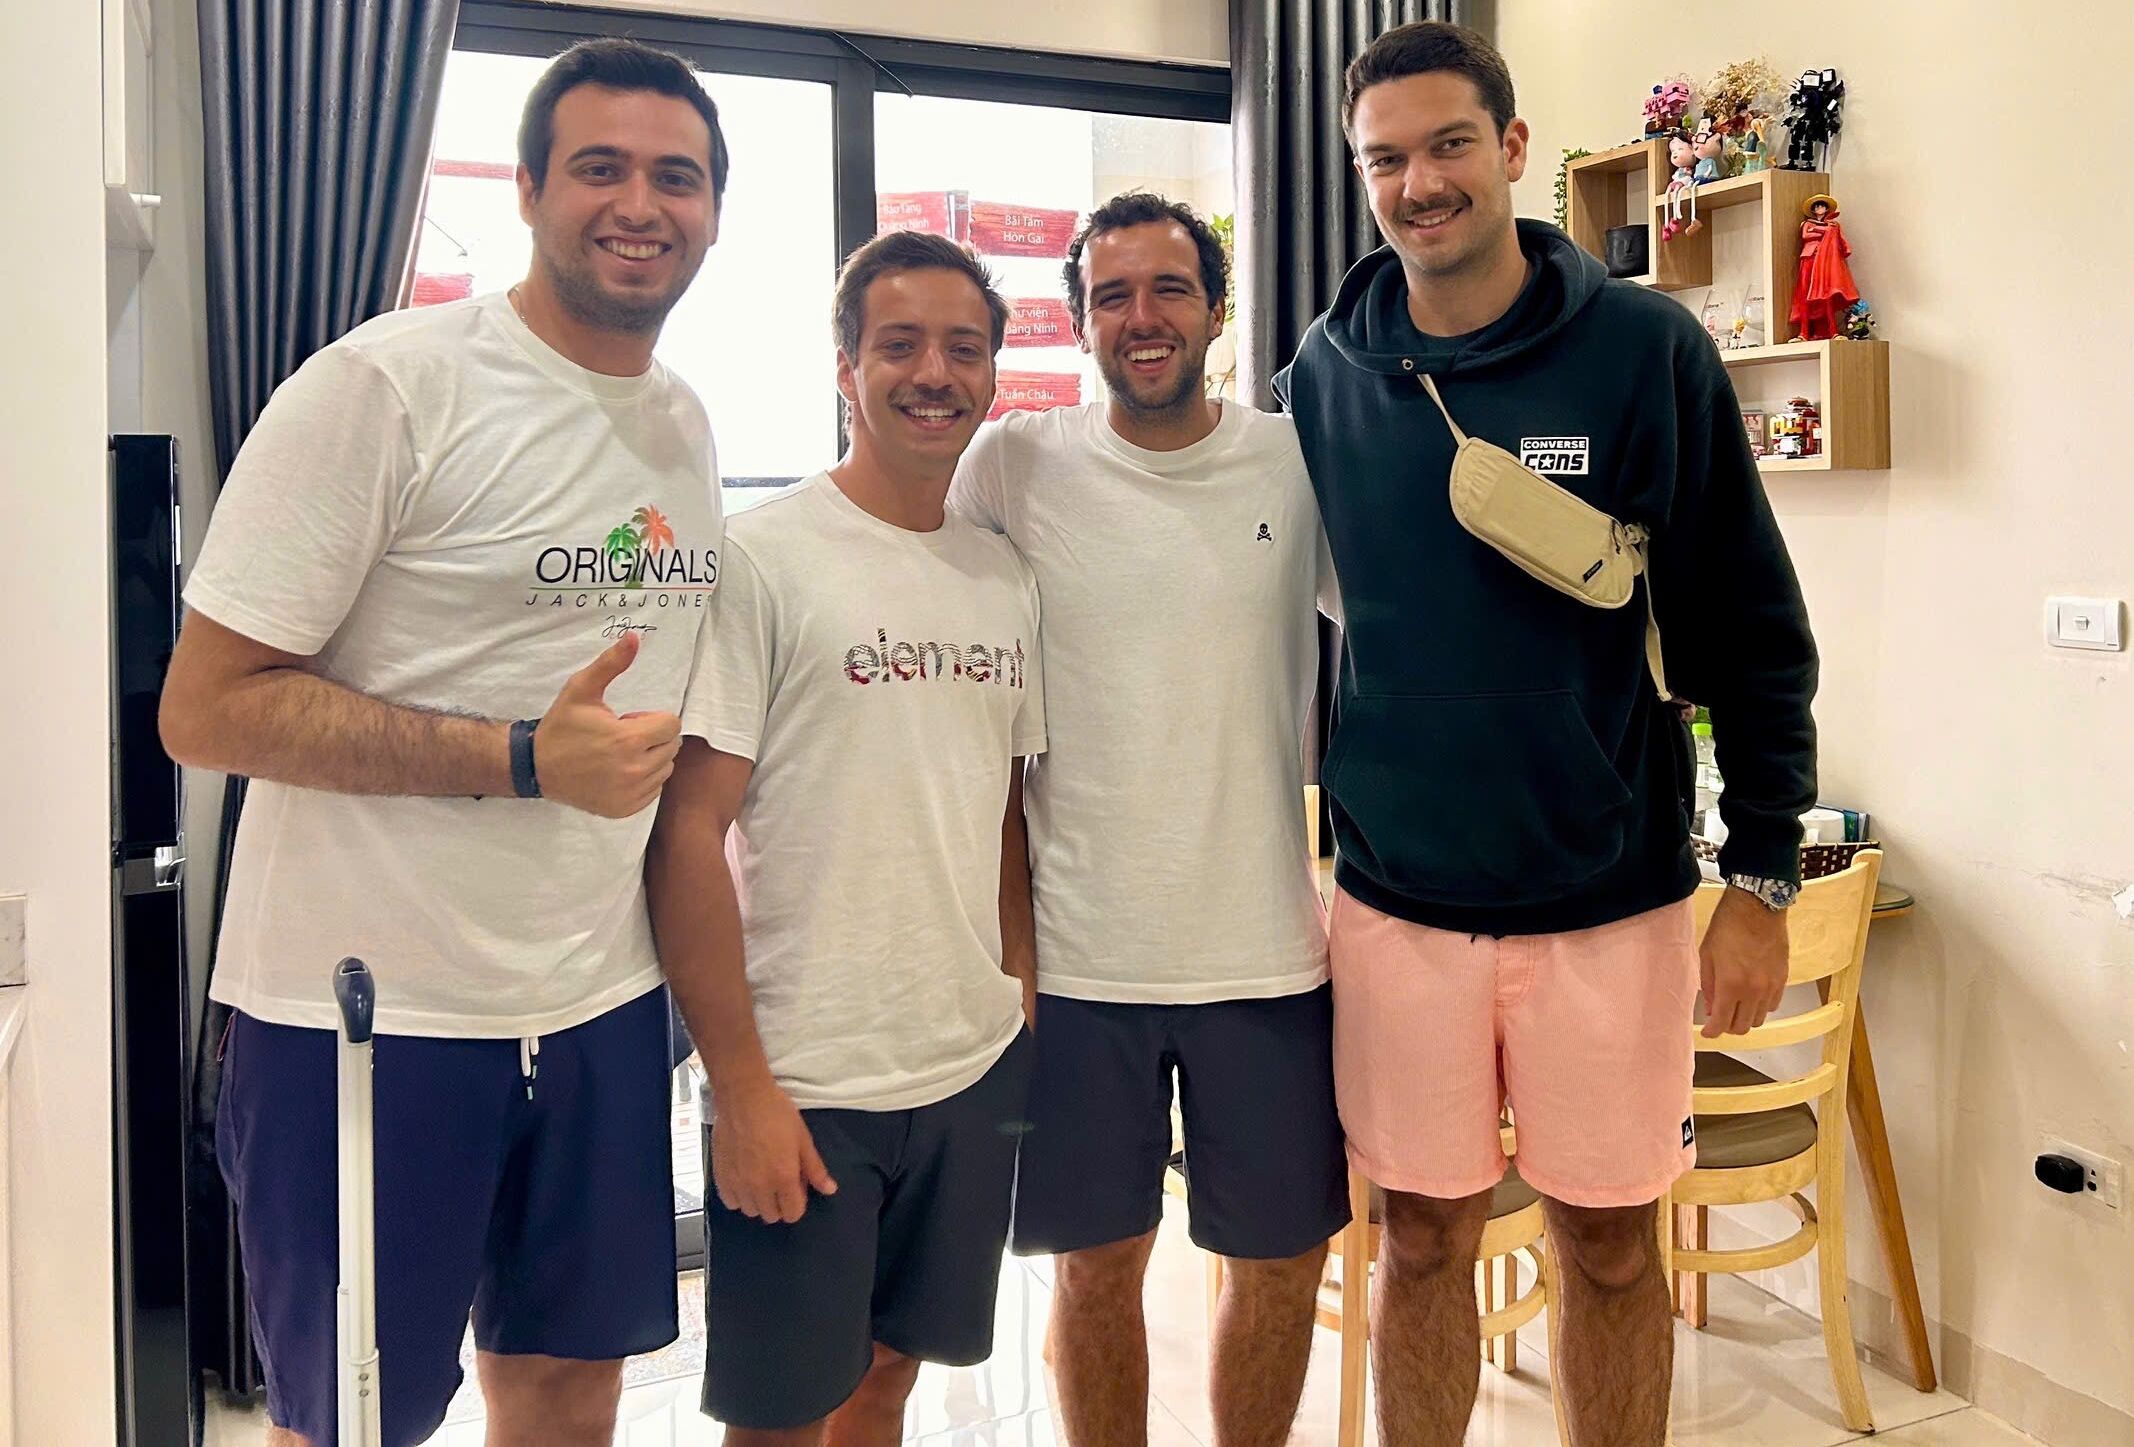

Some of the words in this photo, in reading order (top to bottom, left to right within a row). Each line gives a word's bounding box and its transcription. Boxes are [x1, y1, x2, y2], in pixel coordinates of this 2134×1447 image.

[1026, 306, 1049, 320] viện
[1033, 322, 1058, 333] Ninh
[1523, 440, 1586, 449] CONVERSE
[535, 546, 718, 584] ORIGINALS
[843, 627, 1025, 689] element
